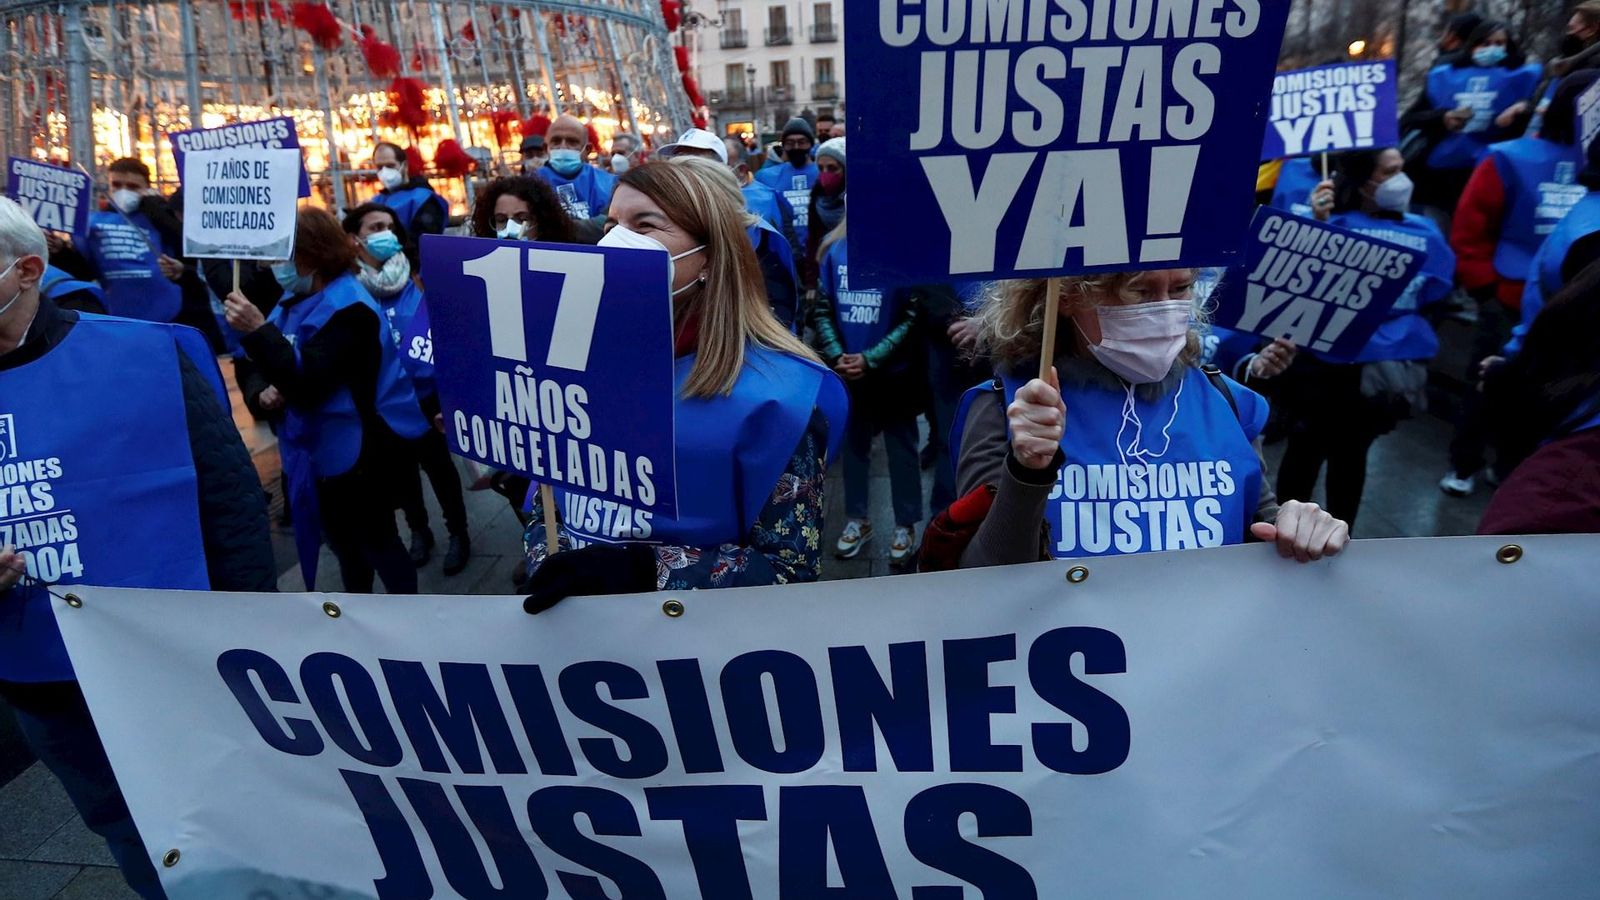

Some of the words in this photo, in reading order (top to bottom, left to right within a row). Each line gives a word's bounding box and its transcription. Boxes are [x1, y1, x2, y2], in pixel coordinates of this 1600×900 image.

[878, 0, 1261, 47] COMISIONES
[909, 43, 1221, 150] JUSTAS
[1272, 63, 1386, 95] OMISIONES
[1270, 84, 1376, 122] JUSTAS
[177, 120, 289, 152] COMISIONES
[1273, 111, 1374, 155] YA!
[18, 176, 79, 208] JUSTAS
[207, 160, 219, 180] 17
[221, 158, 250, 180] AÑOS
[254, 161, 270, 180] DE
[20, 196, 76, 233] YA!
[202, 186, 271, 205] COMISIONES
[918, 145, 1201, 275] YA!
[202, 211, 275, 230] CONGELADAS
[1258, 215, 1413, 280] COMISIONES
[1247, 247, 1383, 310] JUSTAS
[463, 246, 605, 372] 17
[850, 306, 880, 324] 2004
[1235, 282, 1359, 353] YA!
[495, 365, 591, 439] AÑOS
[454, 410, 656, 506] CONGELADAS
[565, 492, 653, 539] JUSTAS
[1056, 498, 1224, 553] JUSTAS
[214, 626, 1132, 779] COMISIONES
[338, 768, 1037, 900] JUSTAS
